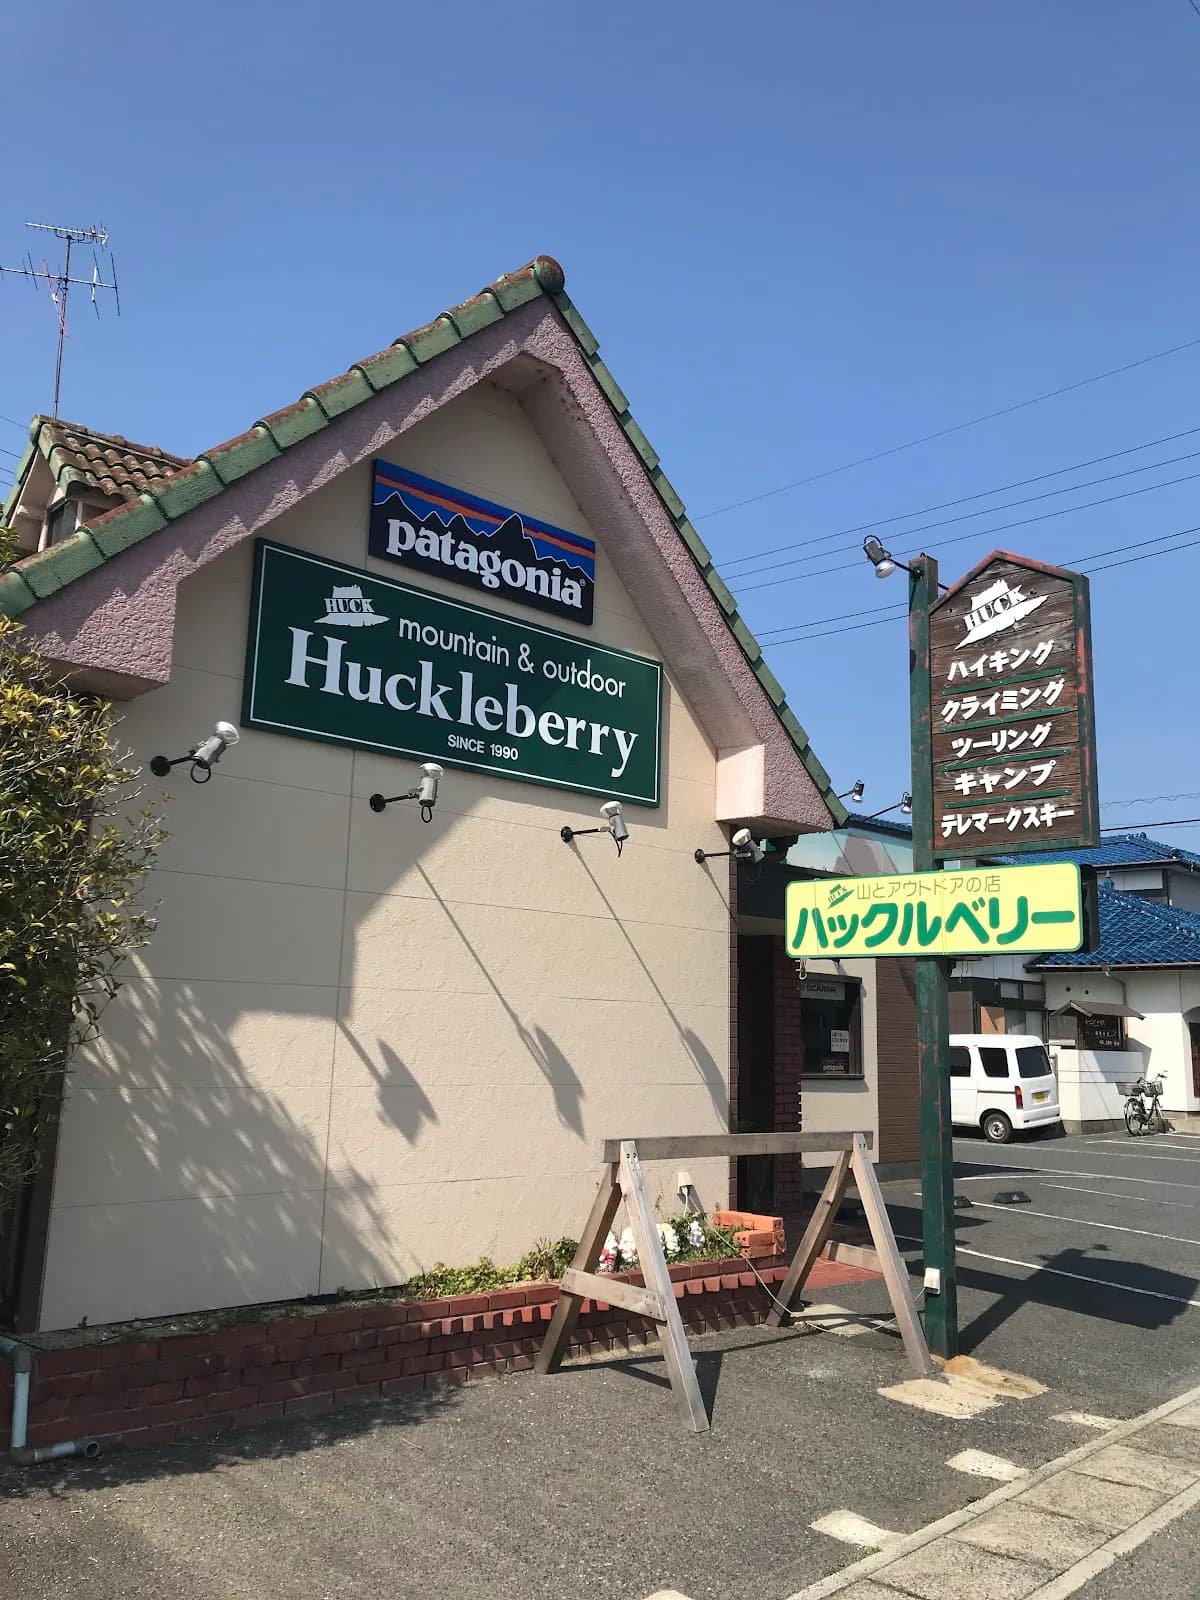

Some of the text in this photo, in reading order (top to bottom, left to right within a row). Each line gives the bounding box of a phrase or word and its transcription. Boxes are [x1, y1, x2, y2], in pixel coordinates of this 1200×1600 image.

[386, 518, 582, 609] patagonia
[324, 598, 375, 613] HUCK
[963, 584, 1028, 632] HUCK
[399, 617, 627, 698] mountain & outdoor
[946, 639, 1055, 682] ハイキング
[284, 626, 639, 779] Huckleberry
[940, 678, 1066, 723] クライミング
[447, 734, 519, 761] SINCE 1990
[951, 721, 1053, 759] ツーリング
[954, 759, 1057, 796] キャンプ
[940, 803, 1075, 839] テレマークスキー
[856, 875, 1001, 900] 山とアウトドアの店
[791, 895, 1076, 950] ハックルベリー
